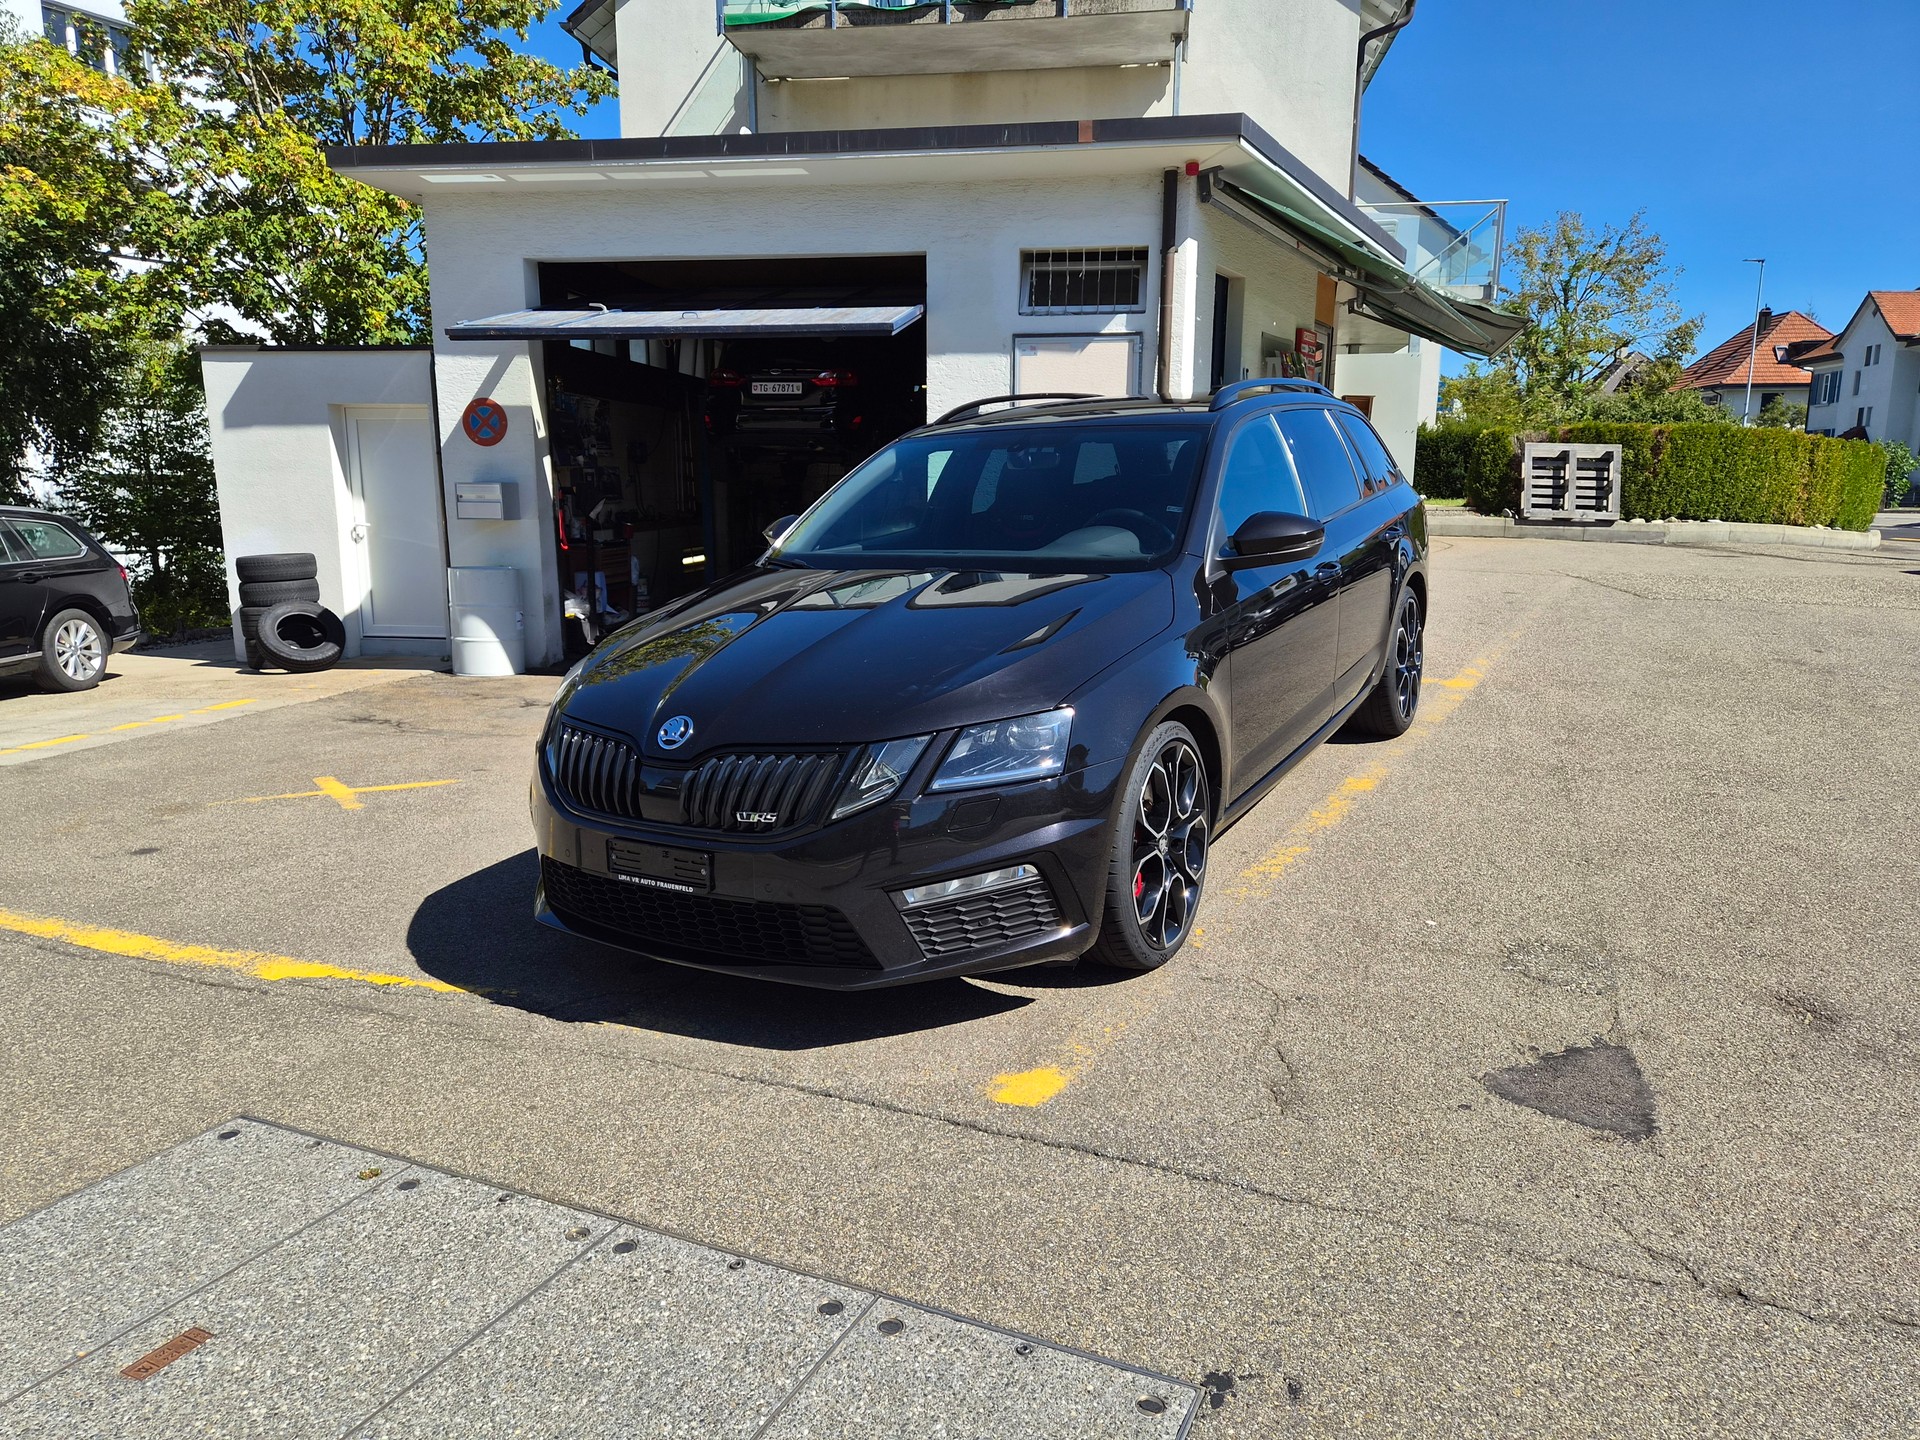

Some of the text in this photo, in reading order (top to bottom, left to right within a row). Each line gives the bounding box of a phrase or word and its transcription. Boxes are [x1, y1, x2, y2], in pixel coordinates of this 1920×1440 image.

[771, 383, 795, 393] 67871
[618, 873, 695, 893] LIMA VR AUTO FRAUENFELD
